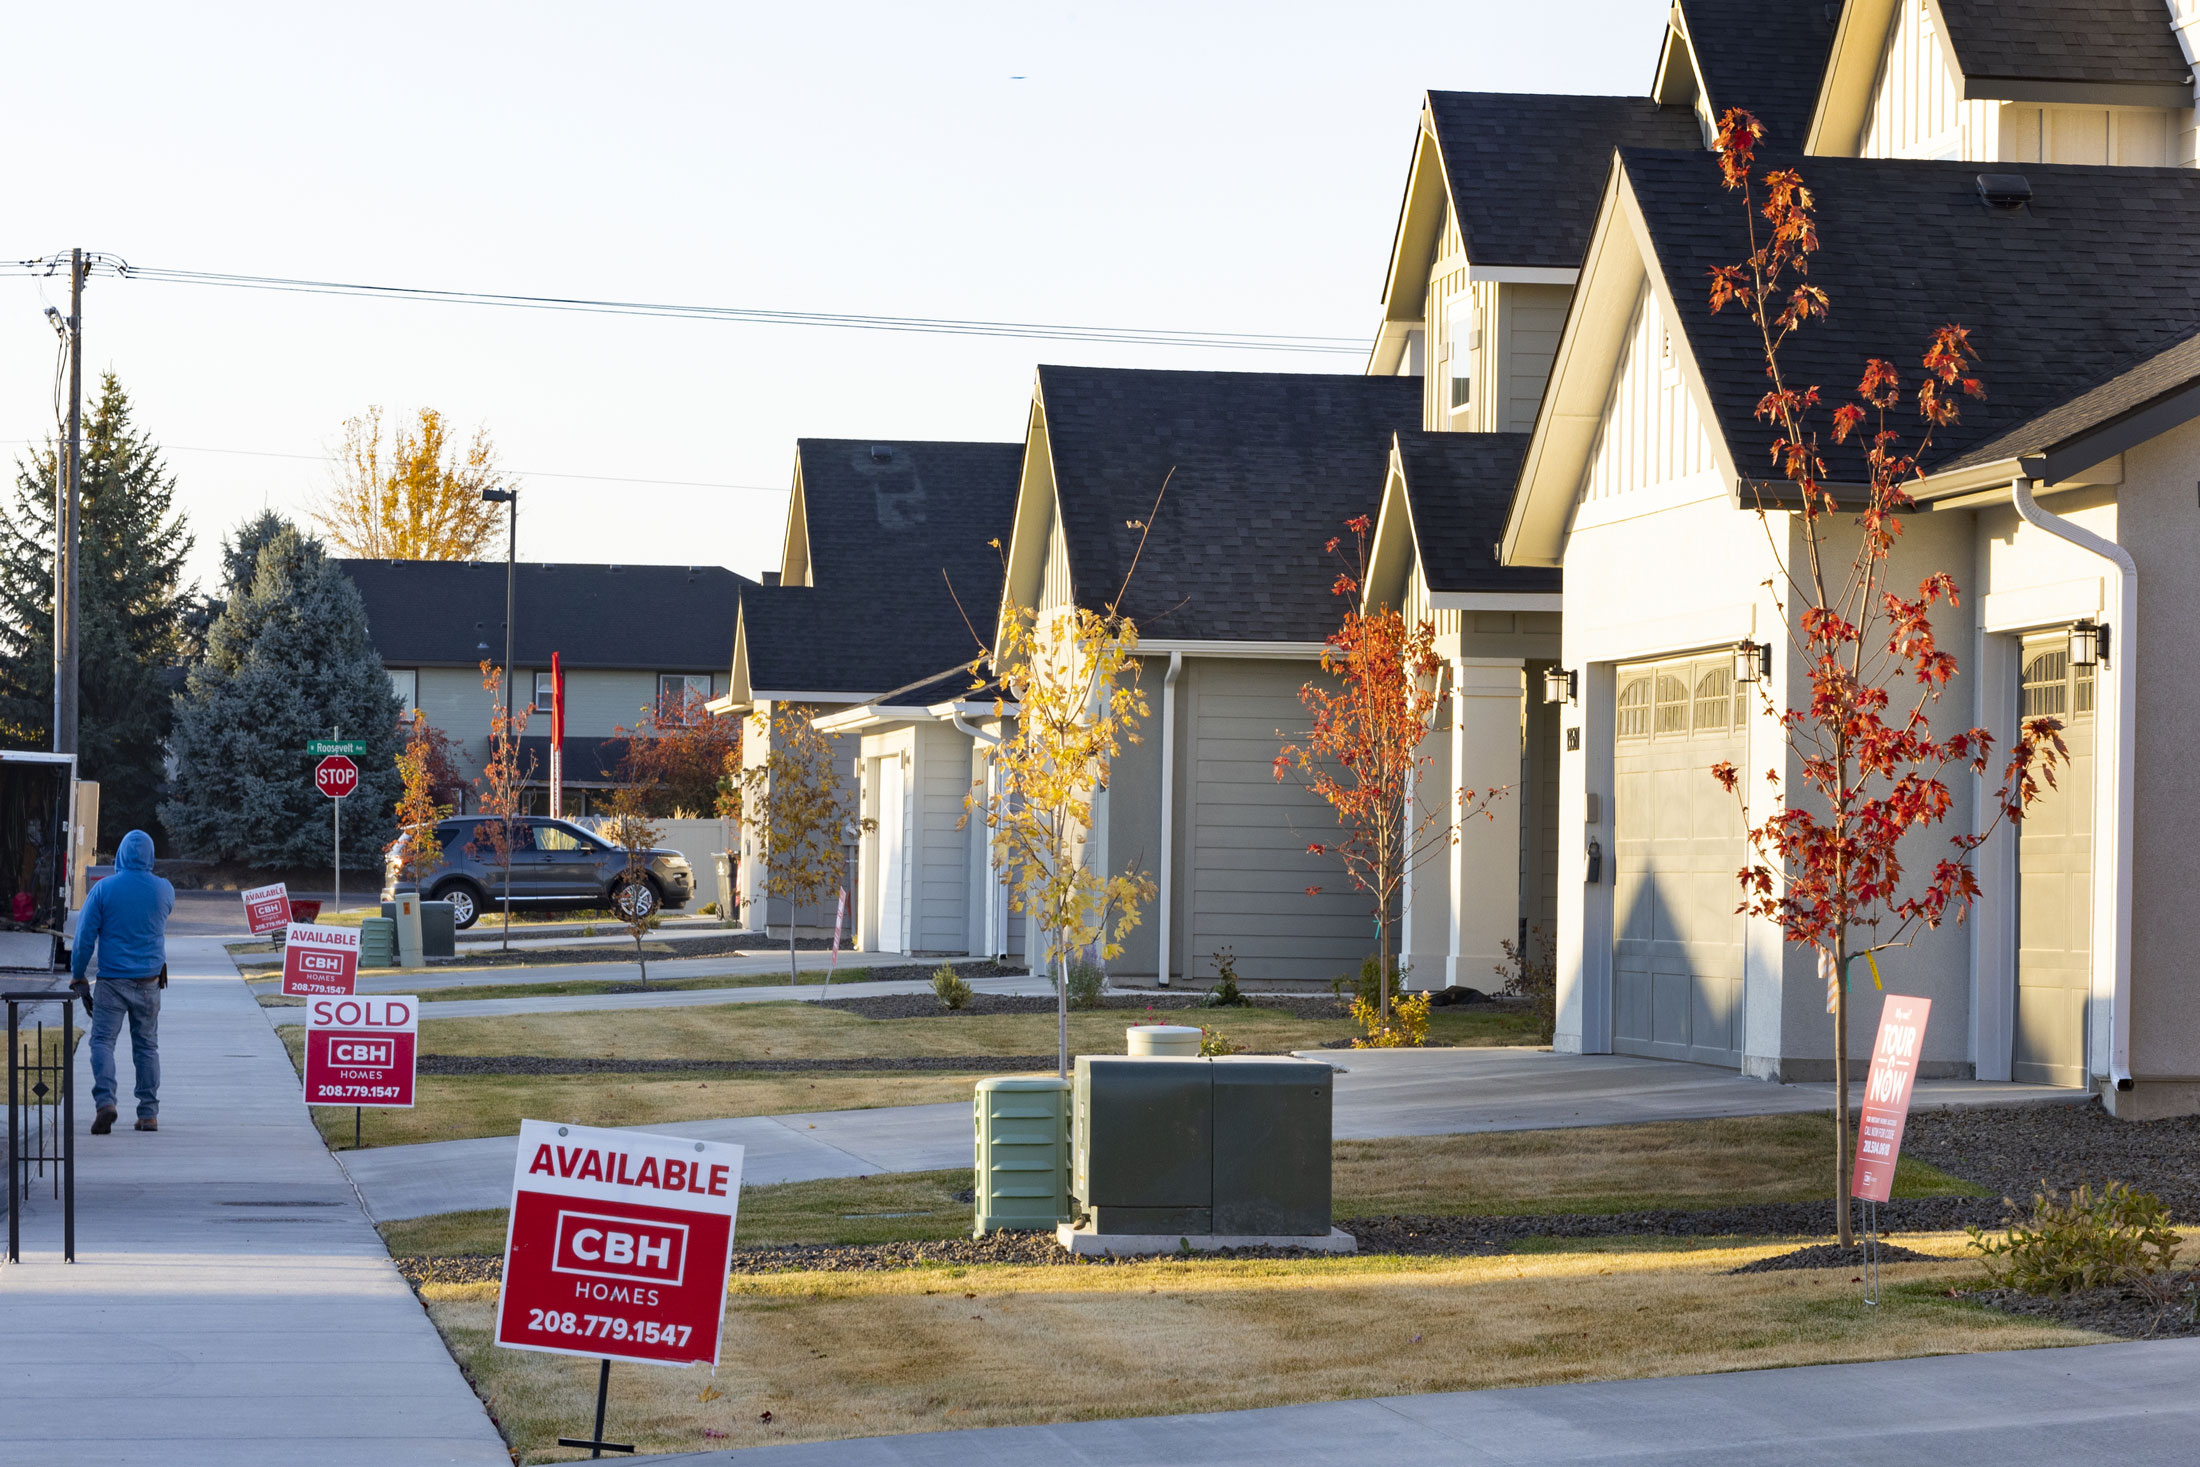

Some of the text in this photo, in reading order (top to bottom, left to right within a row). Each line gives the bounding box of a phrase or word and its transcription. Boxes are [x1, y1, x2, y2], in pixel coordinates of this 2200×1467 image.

[316, 742, 354, 753] Roosevelt
[318, 768, 355, 785] STOP
[245, 887, 284, 901] AVAILABLE
[258, 904, 278, 915] CBH
[290, 930, 357, 946] AVAILABLE
[305, 956, 338, 970] CBH
[306, 973, 335, 982] HOMES
[291, 982, 346, 995] 208.779.1547
[313, 1001, 410, 1026] SOLD
[1881, 1023, 1916, 1058] TOUR
[336, 1044, 386, 1062] CBH
[340, 1070, 383, 1080] HOMES
[318, 1084, 400, 1098] 208.779.1547
[1870, 1067, 1908, 1105] NOW
[528, 1143, 730, 1197] AVAILABLE
[572, 1228, 671, 1270] CBH
[575, 1281, 660, 1307] HOMES
[528, 1308, 692, 1348] 208.779.1547
